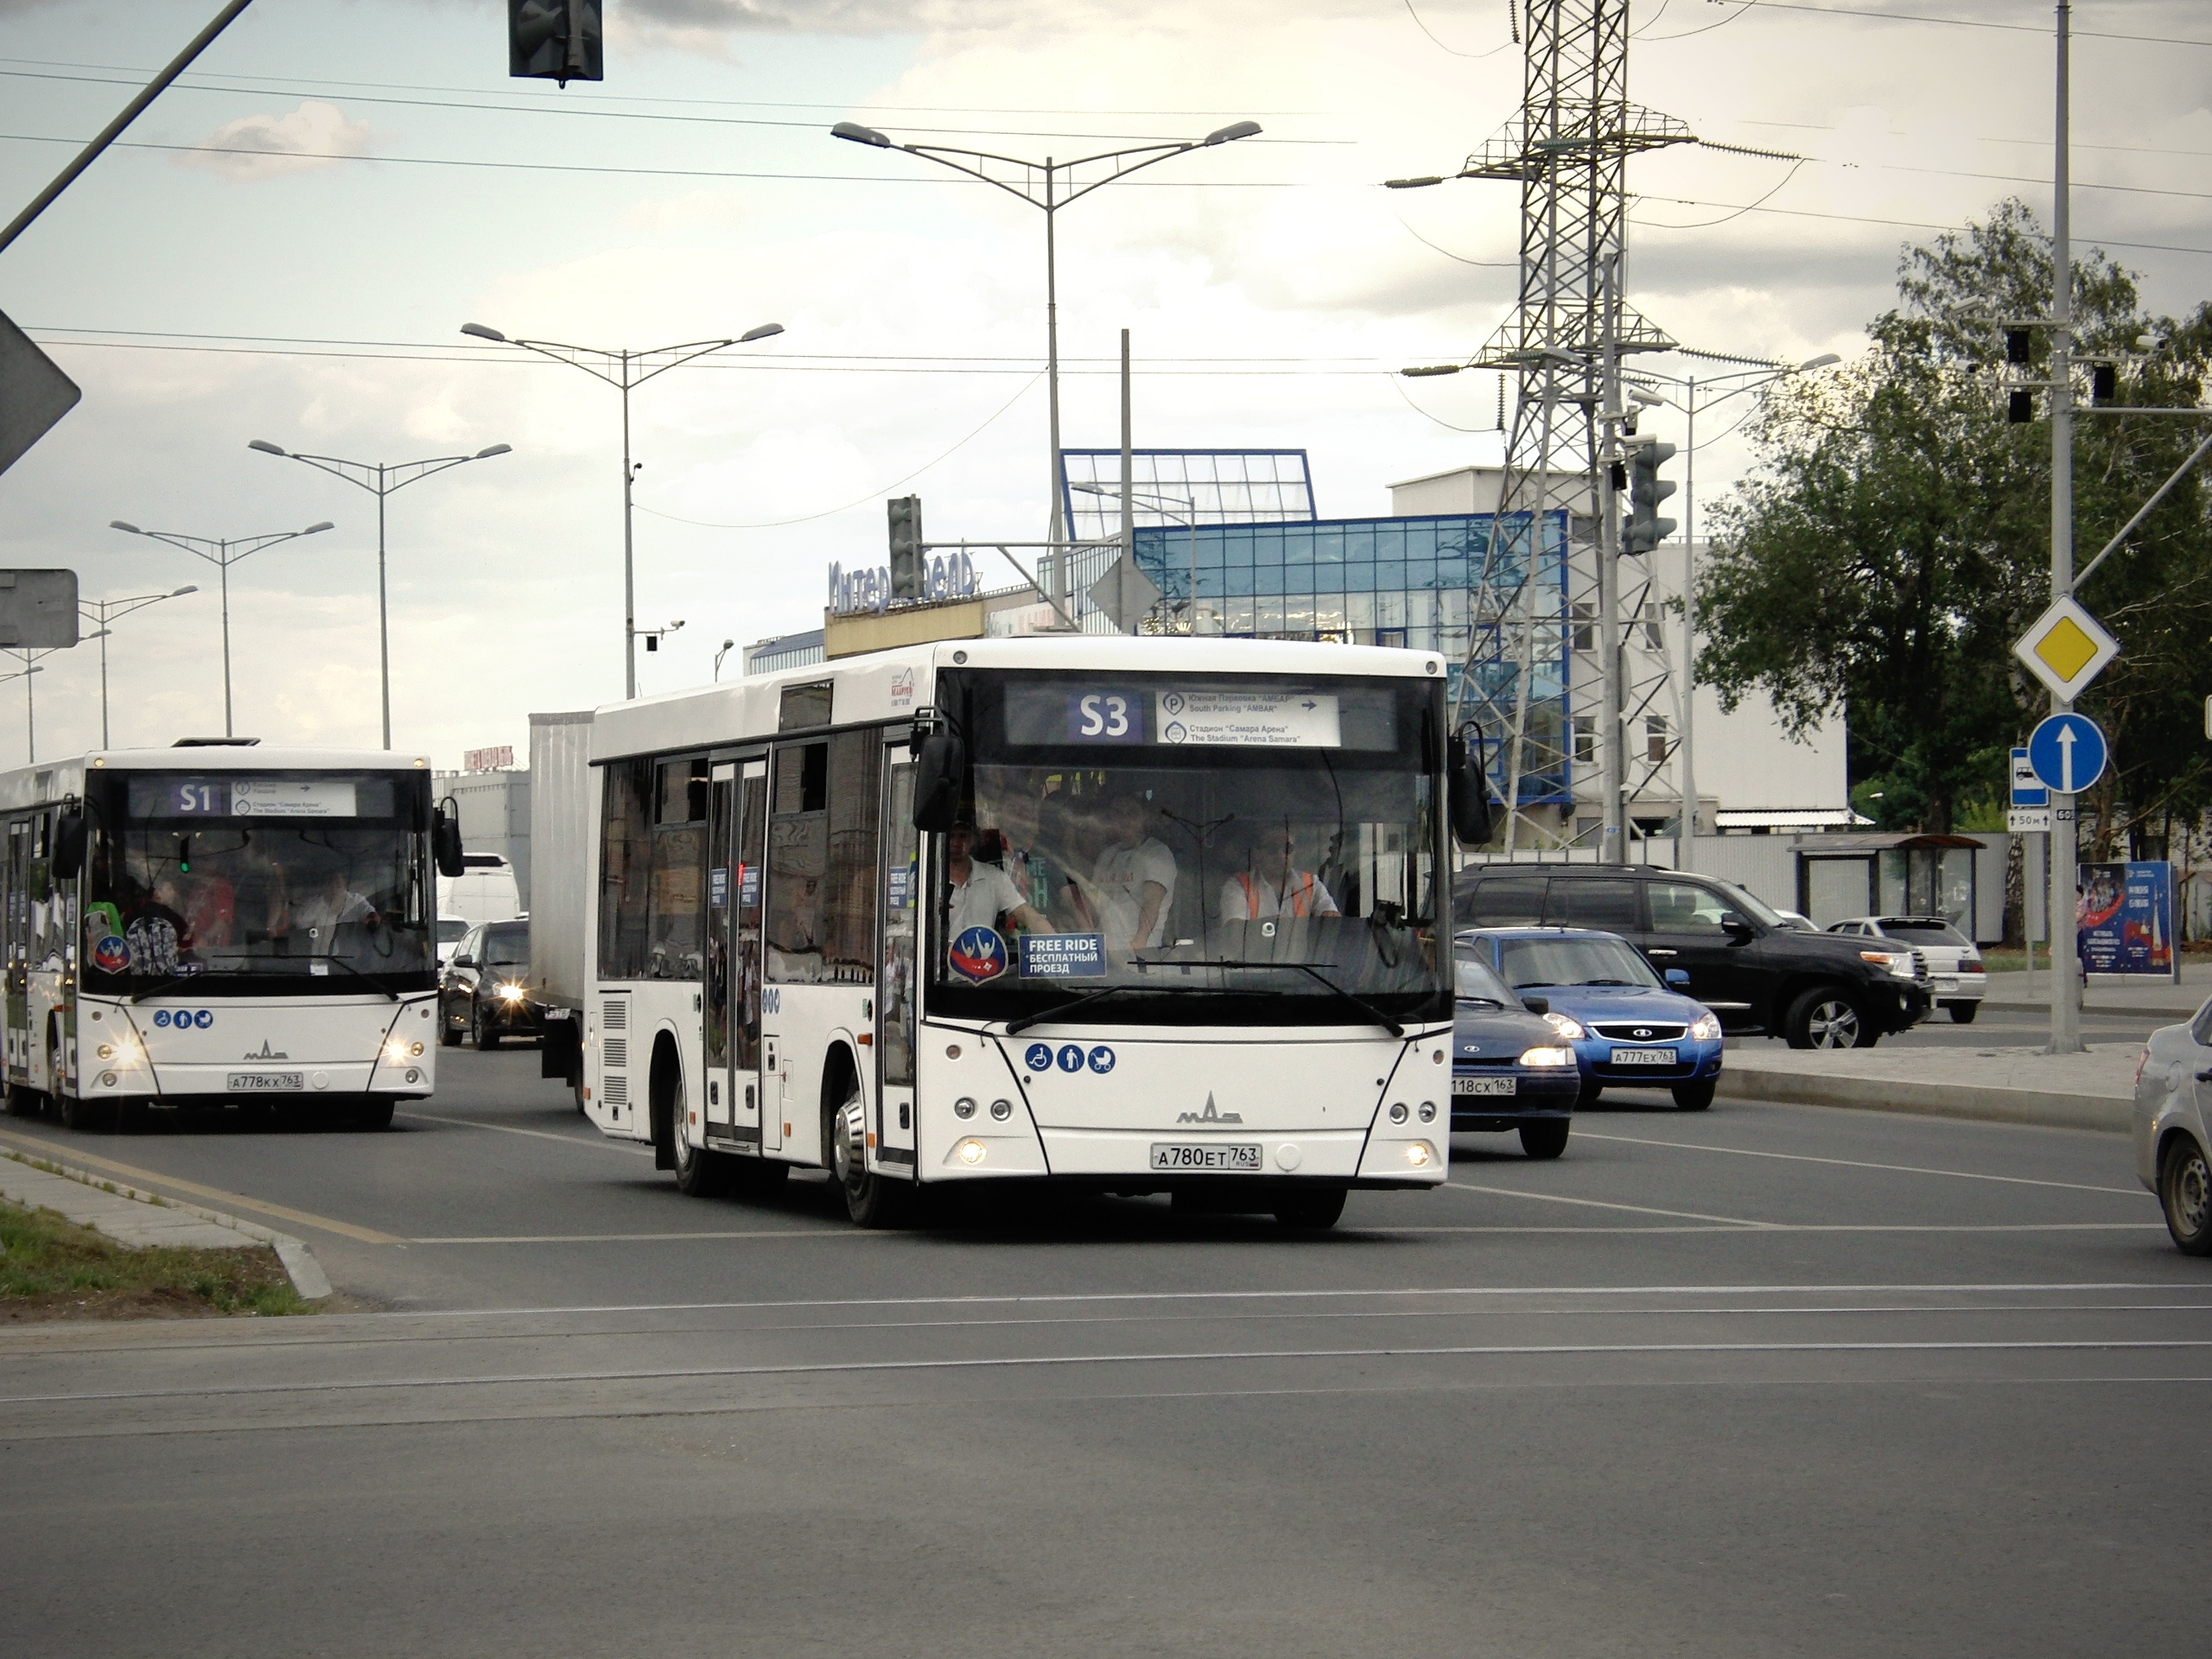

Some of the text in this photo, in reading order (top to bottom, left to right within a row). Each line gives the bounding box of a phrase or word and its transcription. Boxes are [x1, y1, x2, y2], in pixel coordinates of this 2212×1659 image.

[1189, 704, 1211, 713] South
[1213, 704, 1242, 714] Parking
[1080, 694, 1128, 736] S3
[1189, 724, 1224, 734] Стадион
[1208, 734, 1238, 743] Stadium
[180, 784, 211, 810] S1
[1029, 939, 1097, 951] FREE RIDE
[1029, 952, 1097, 963] БЕСПЛАТНЫЙ
[1029, 963, 1070, 974] ПРОЕЗД
